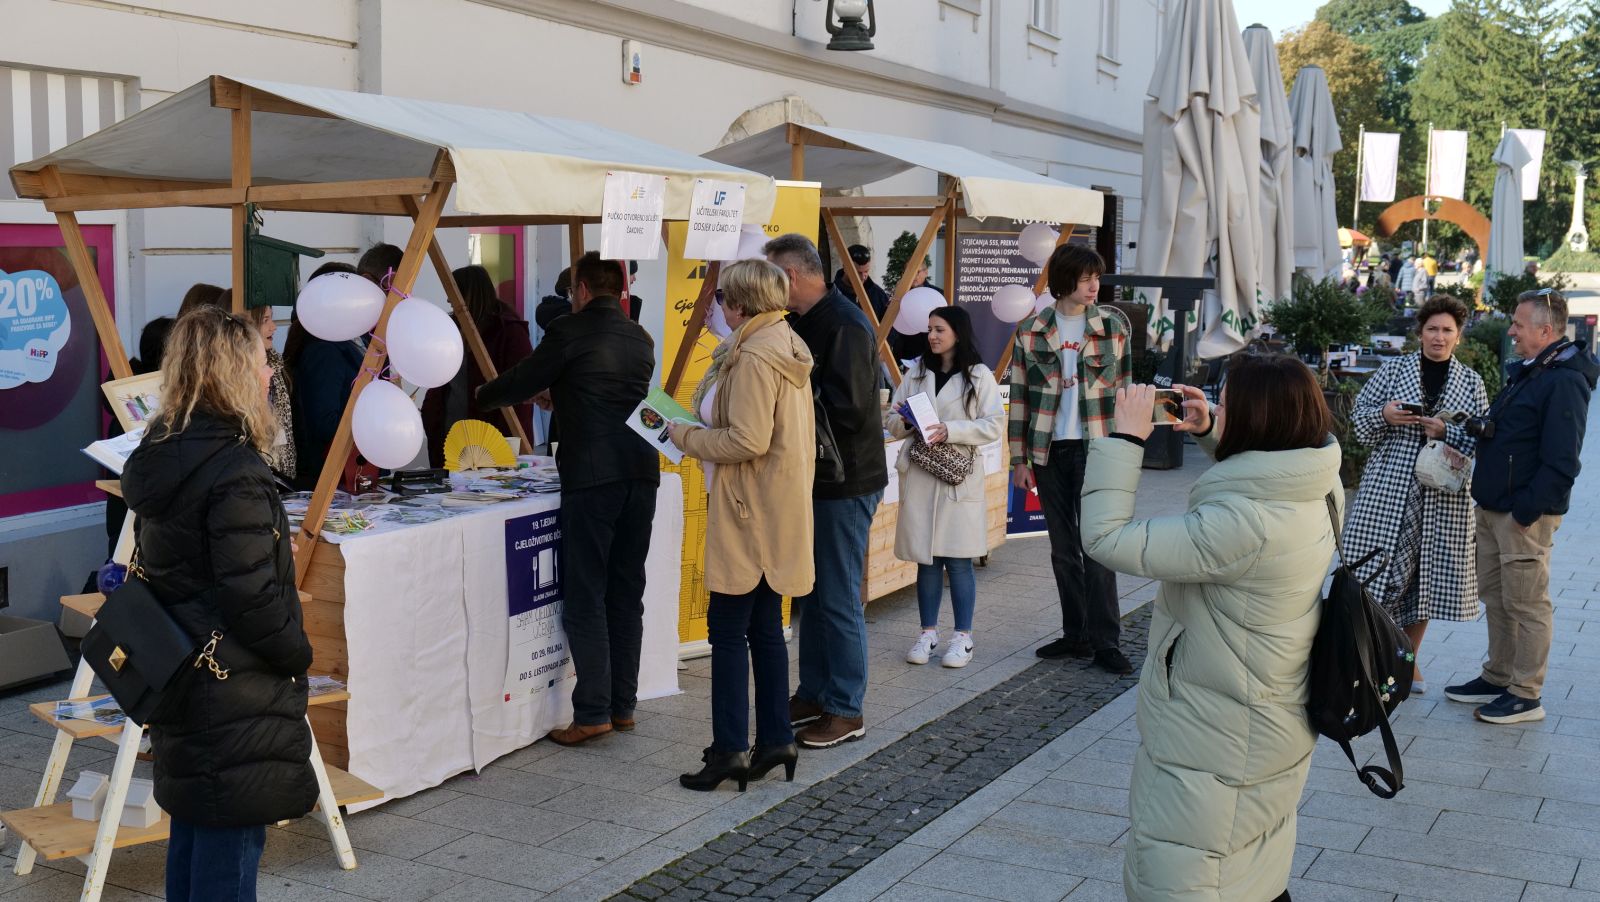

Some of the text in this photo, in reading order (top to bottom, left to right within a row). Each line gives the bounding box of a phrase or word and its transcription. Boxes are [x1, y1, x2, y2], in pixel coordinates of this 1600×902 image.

[547, 643, 563, 655] RUJNA
[519, 672, 528, 681] DO
[534, 661, 558, 676] LISTOPADA
